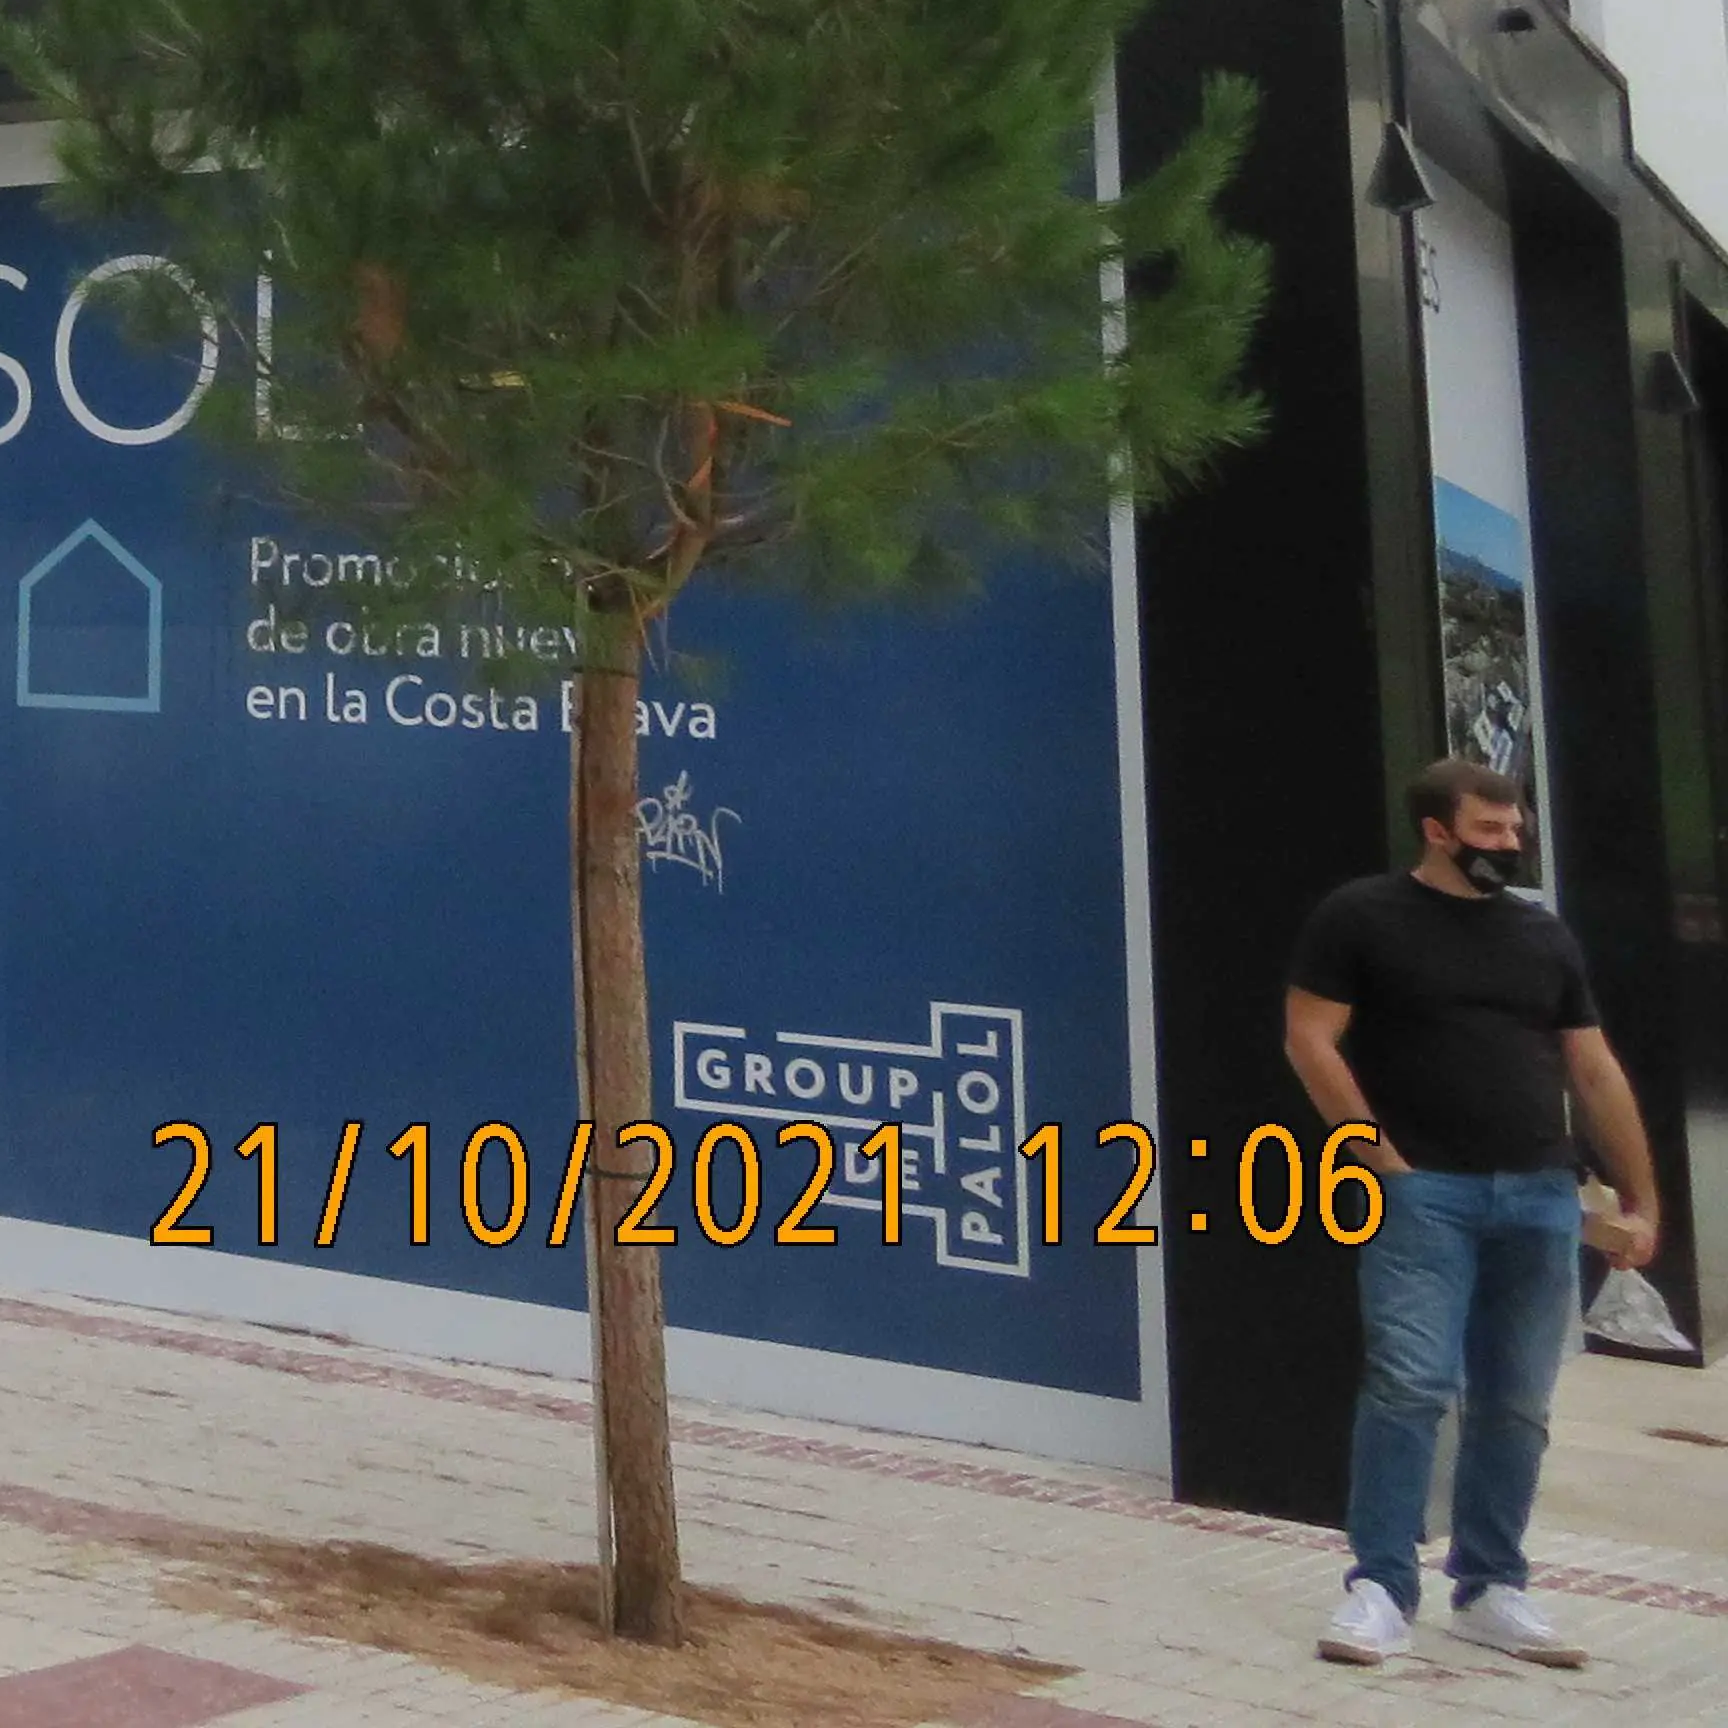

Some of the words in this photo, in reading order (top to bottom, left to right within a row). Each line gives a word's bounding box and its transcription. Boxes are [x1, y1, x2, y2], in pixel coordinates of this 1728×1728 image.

[246, 604, 310, 654] de
[460, 622, 602, 662] nuev
[246, 681, 307, 723] en
[325, 671, 368, 725] la
[385, 673, 540, 733] Costa
[560, 680, 717, 740] Bava
[696, 1048, 920, 1110] GROUP
[844, 1141, 922, 1192] DE
[955, 1029, 1006, 1246] PALOL
